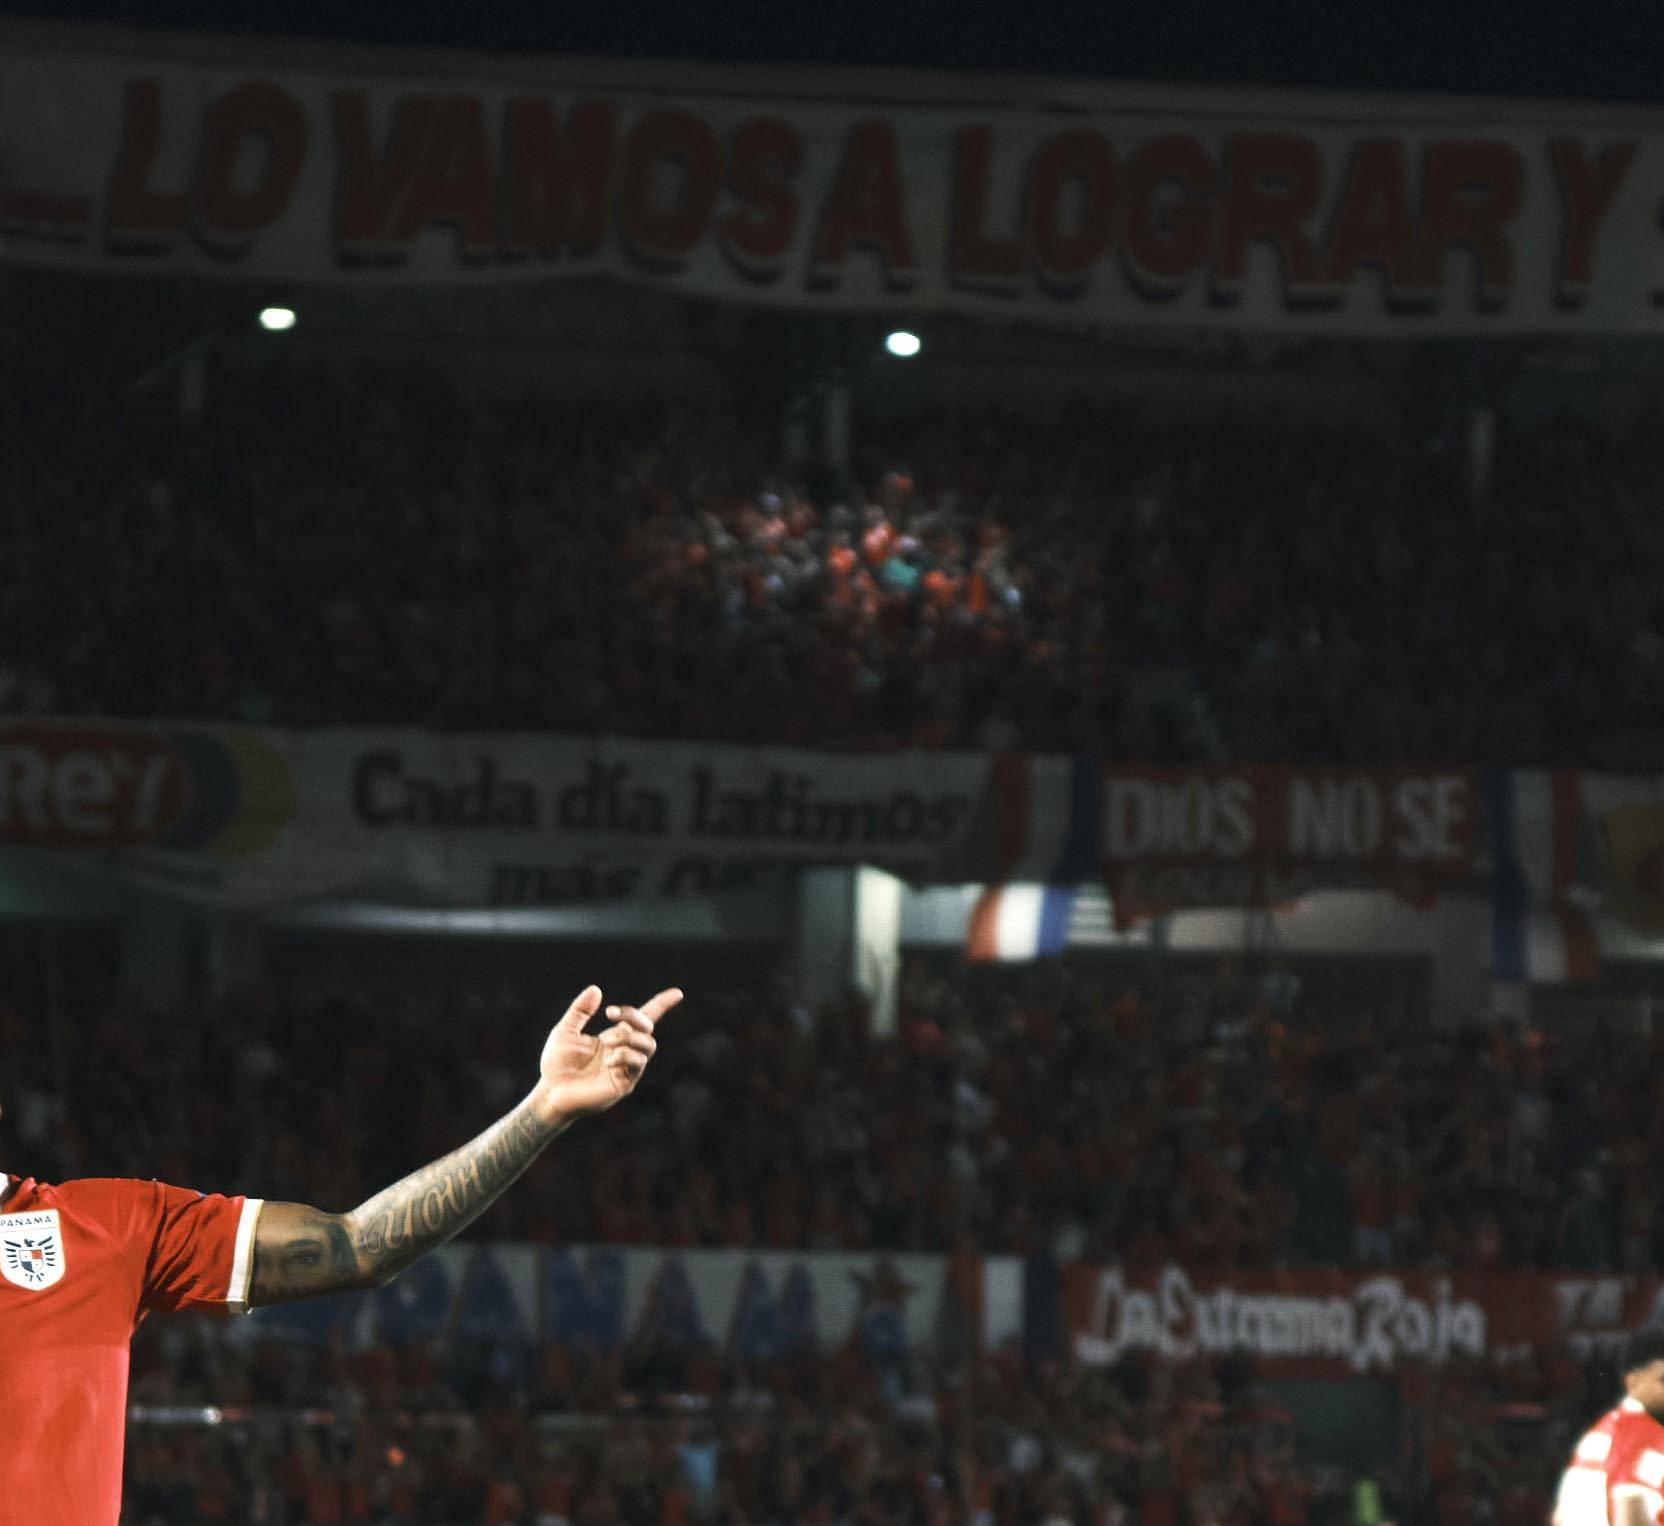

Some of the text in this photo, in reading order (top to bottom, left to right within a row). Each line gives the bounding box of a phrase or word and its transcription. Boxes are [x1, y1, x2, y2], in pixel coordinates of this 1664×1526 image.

[106, 80, 308, 255] LO
[338, 91, 800, 284] VAMOS
[806, 120, 918, 290] A
[351, 752, 972, 845] Cada día latimos
[1106, 775, 1467, 860] DIOS NO SE
[0, 1215, 52, 1227] PANAMA
